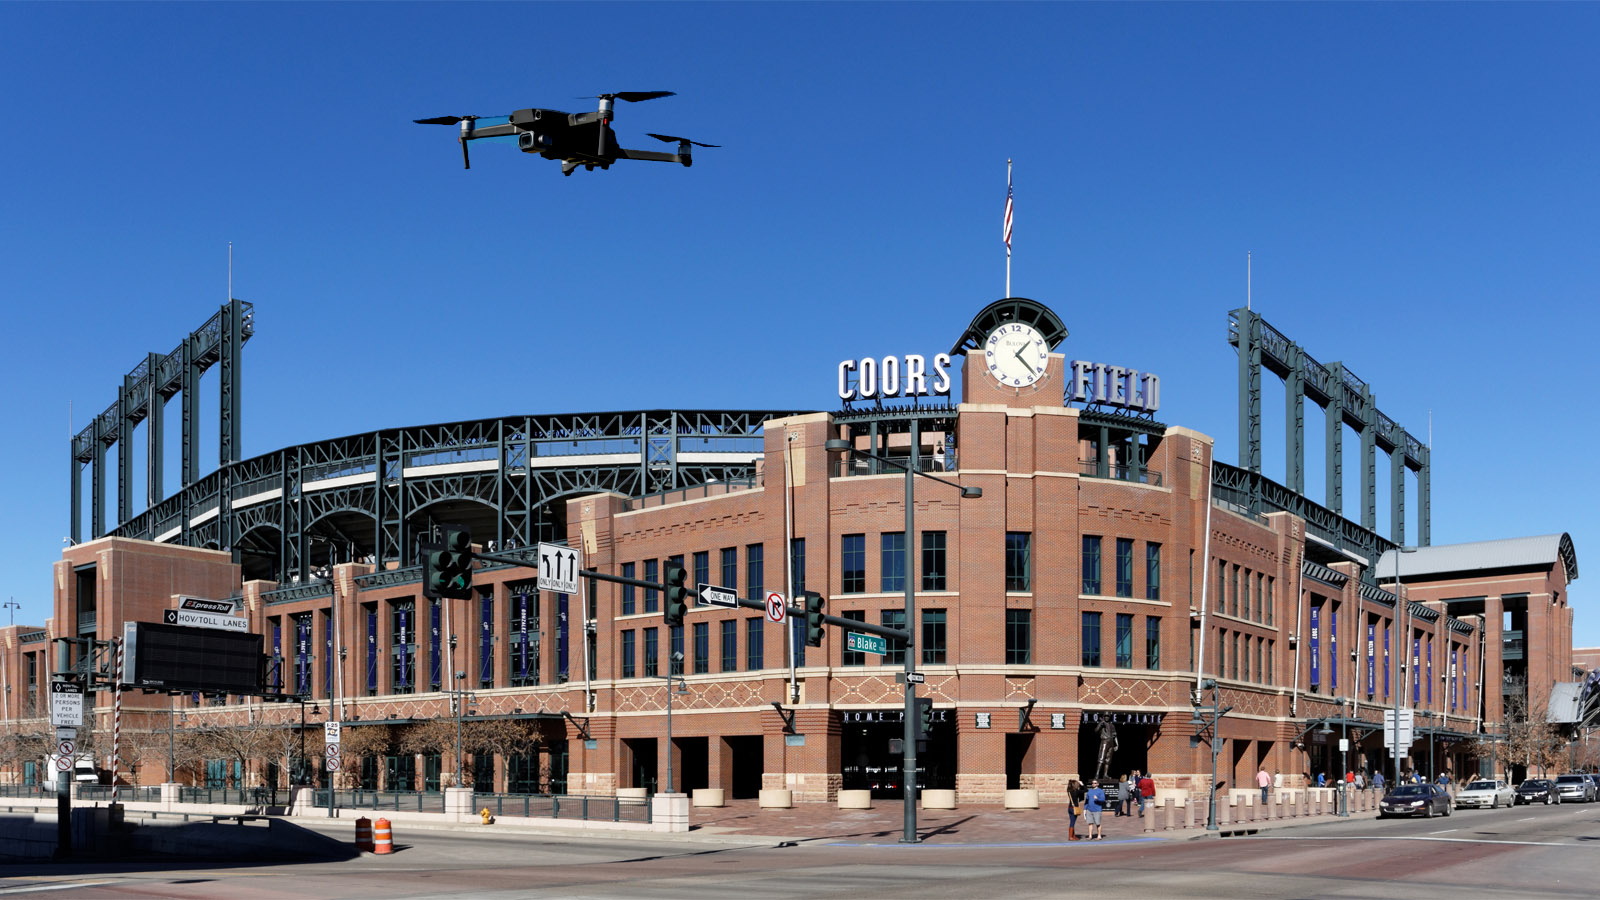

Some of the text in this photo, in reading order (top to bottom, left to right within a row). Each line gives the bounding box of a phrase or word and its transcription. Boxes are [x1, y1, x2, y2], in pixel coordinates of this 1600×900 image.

[999, 327, 1007, 335] 11
[989, 335, 998, 345] 10
[838, 352, 951, 399] COORS
[1070, 360, 1160, 412] FIELD
[540, 578, 551, 586] ONLY
[552, 580, 563, 588] ONLY
[565, 582, 576, 590] ONLY
[711, 591, 733, 602] ONE WAY
[179, 614, 247, 628] HOV/TOLL LANES
[857, 637, 877, 651] Blake
[844, 712, 884, 721] HOME
[1083, 713, 1161, 724] HOE PLATE
